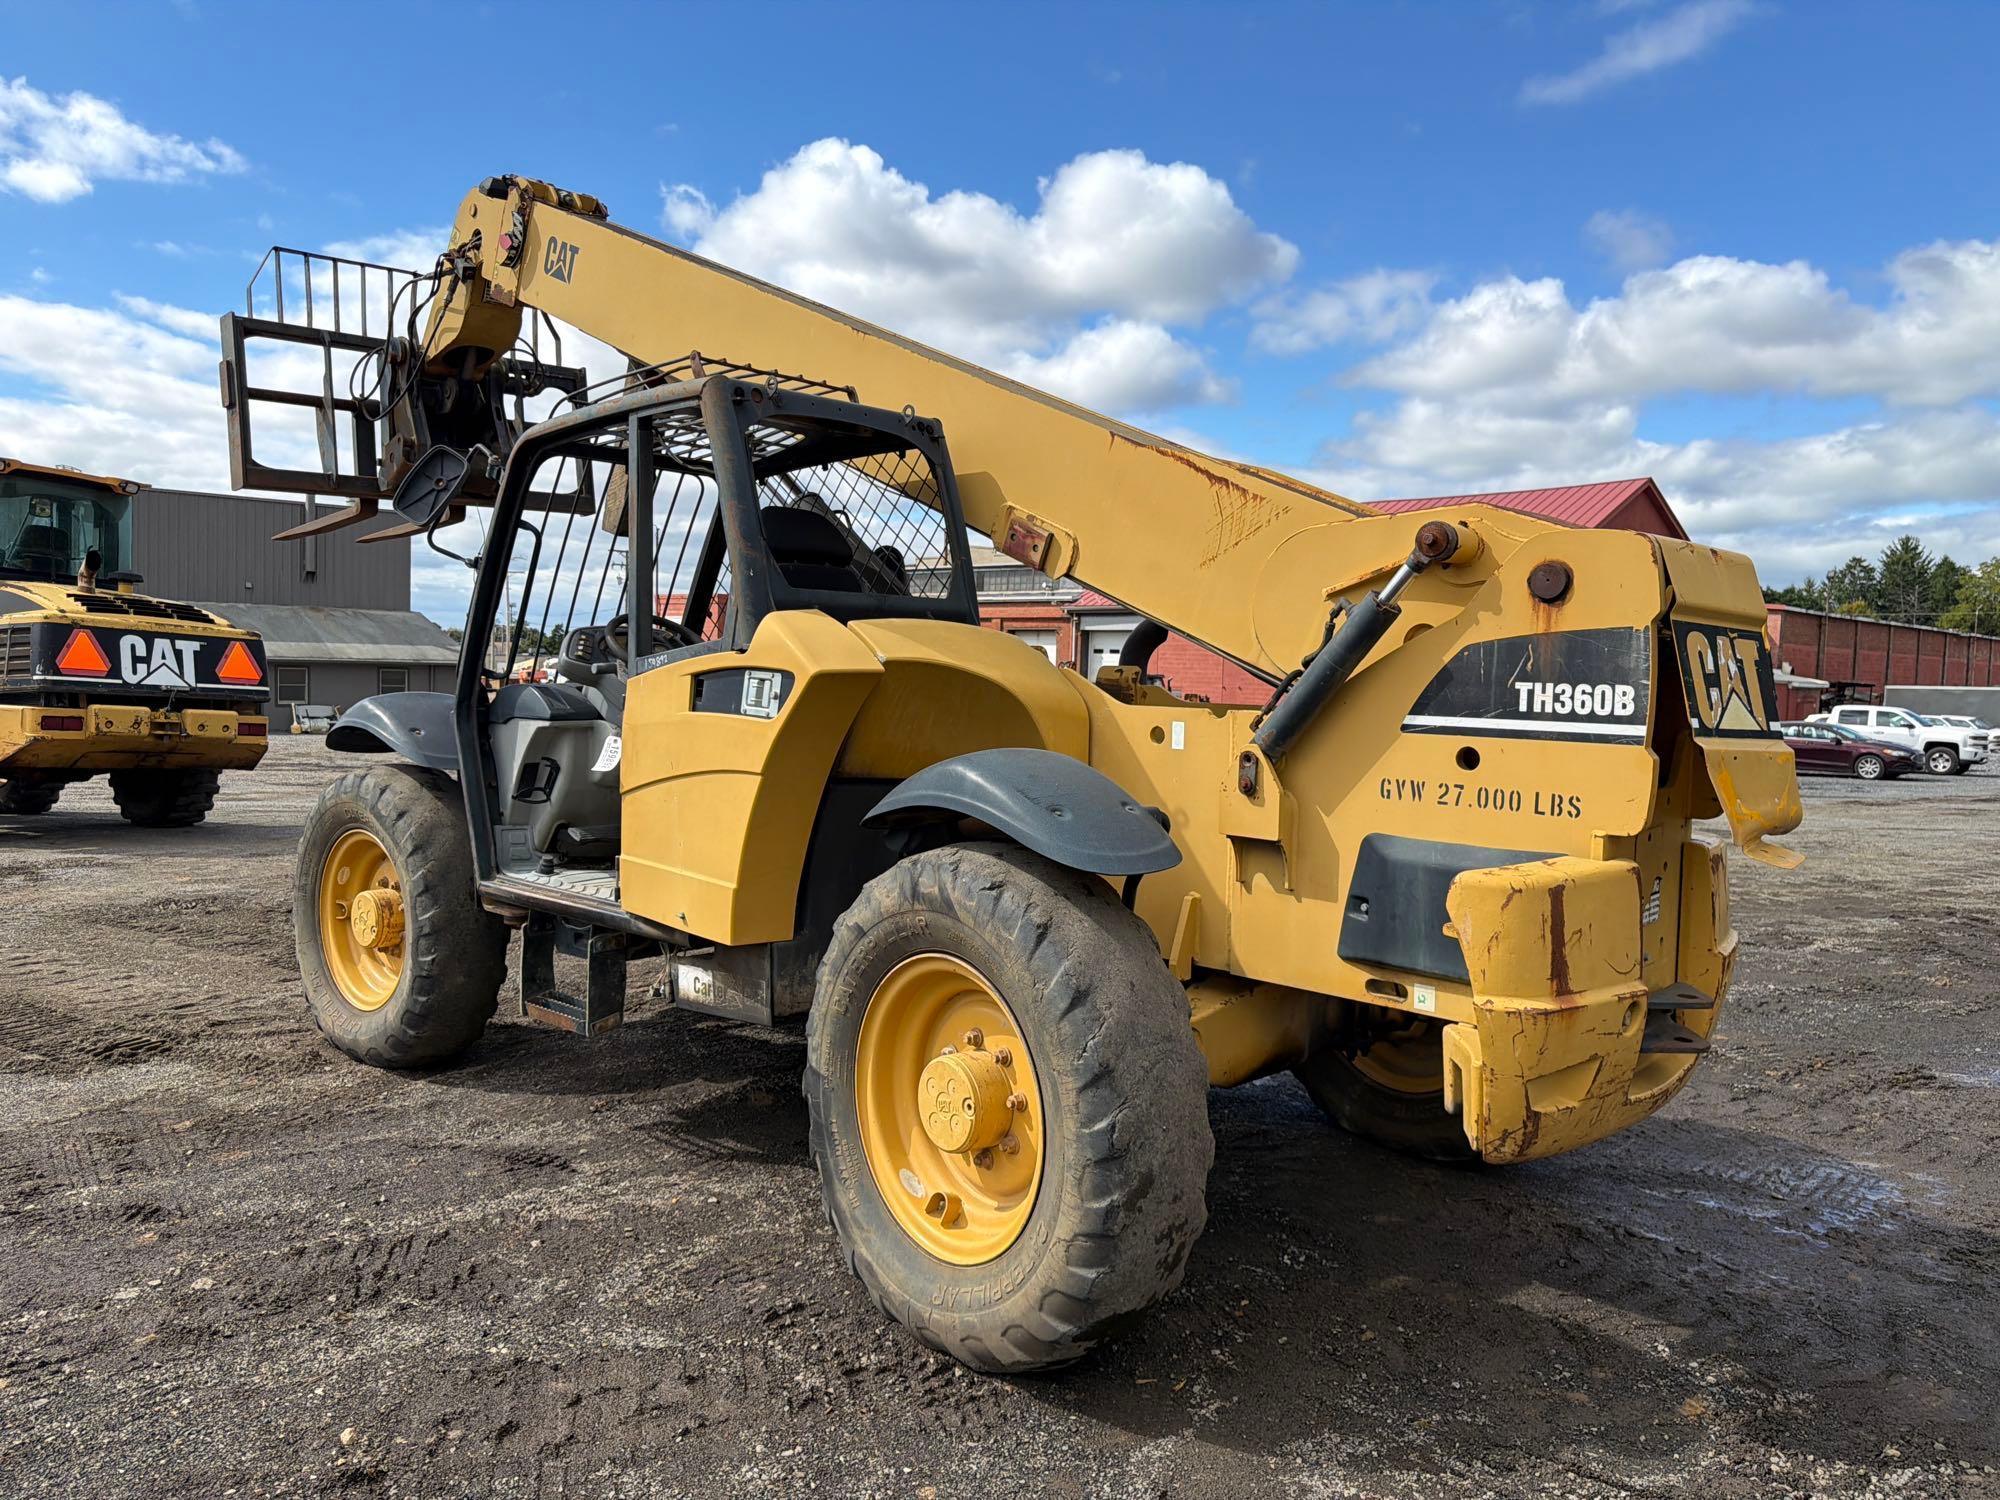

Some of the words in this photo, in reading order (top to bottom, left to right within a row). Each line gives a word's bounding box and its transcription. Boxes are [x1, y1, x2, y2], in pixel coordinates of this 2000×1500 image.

[544, 235, 580, 285] CAT
[119, 635, 201, 687] CAT
[1686, 631, 1769, 732] CAT
[1515, 682, 1635, 716] TH360B
[1379, 777, 1426, 803] GVW
[1437, 782, 1522, 813] 27.000
[1533, 791, 1582, 819] LBS
